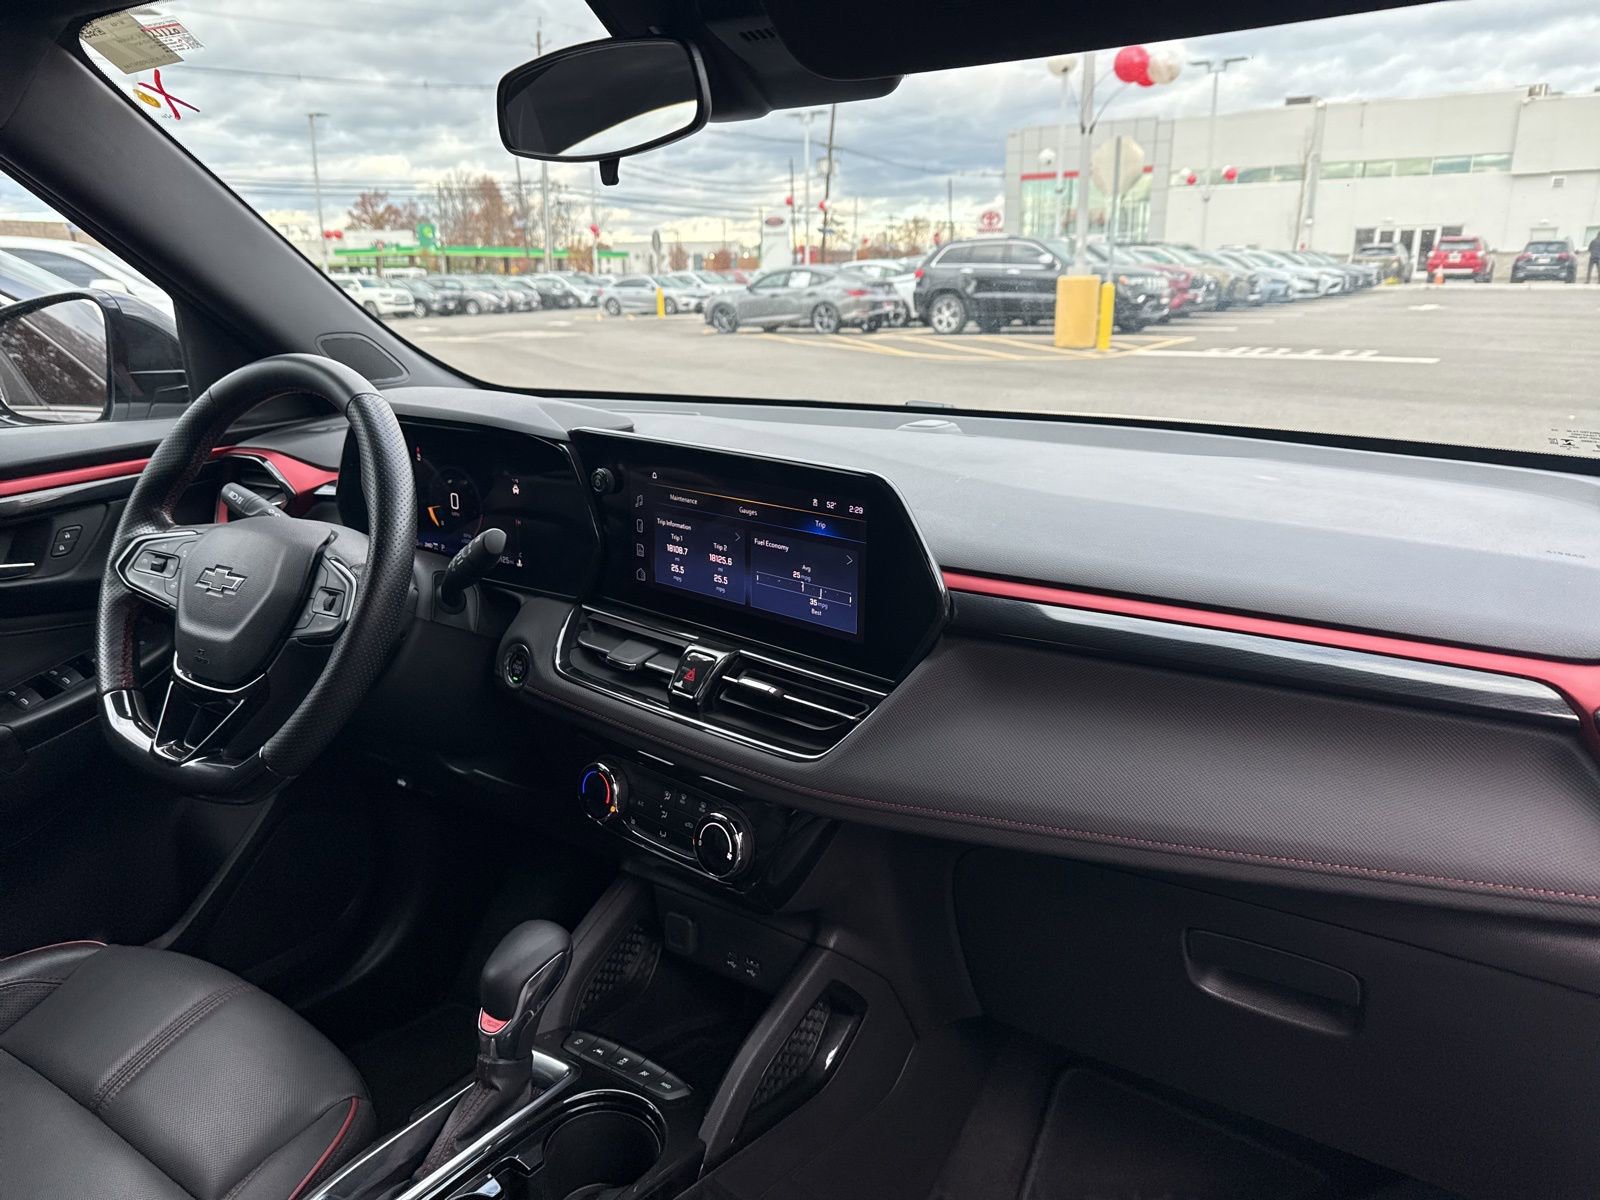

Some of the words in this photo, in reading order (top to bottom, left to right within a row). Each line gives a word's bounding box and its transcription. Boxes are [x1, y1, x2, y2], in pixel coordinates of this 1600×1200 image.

[669, 494, 698, 505] Maintenance
[738, 506, 758, 517] Gauges
[815, 520, 827, 529] Trip
[848, 505, 864, 515] 2:29
[657, 518, 666, 527] Trip
[666, 521, 692, 531] Information
[671, 534, 679, 542] Trip
[713, 542, 723, 551] Trip
[754, 538, 765, 546] Fuel
[765, 541, 789, 552] Economy
[671, 564, 685, 574] 25.5
[802, 564, 811, 573] Avg
[713, 573, 728, 585] 25.5
[792, 570, 800, 579] 25
[809, 598, 818, 606] 35
[811, 608, 822, 616] Best
